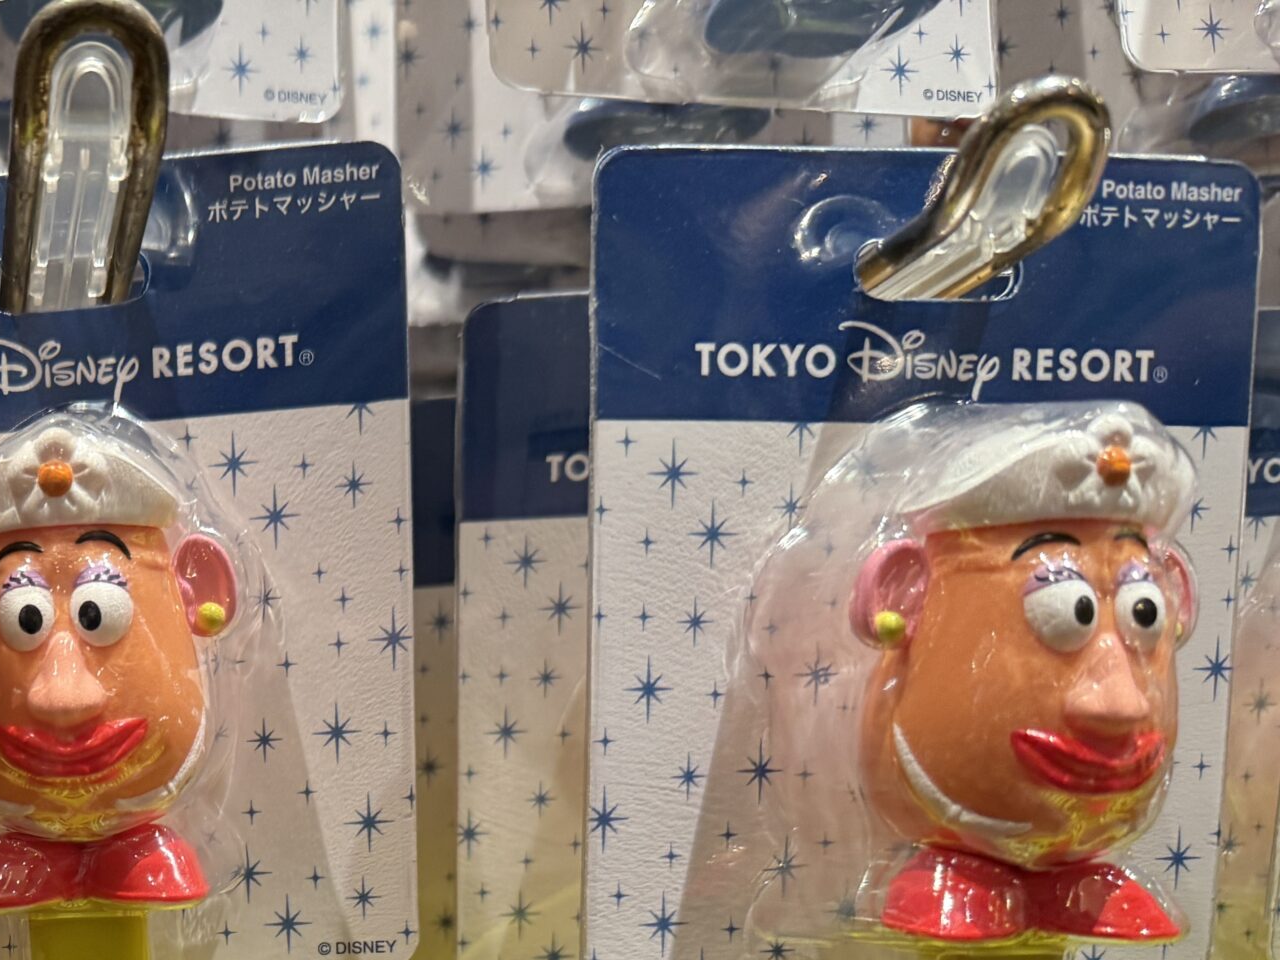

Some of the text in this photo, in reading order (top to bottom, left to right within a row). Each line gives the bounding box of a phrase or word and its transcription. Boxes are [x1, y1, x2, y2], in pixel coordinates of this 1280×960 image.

[277, 90, 327, 104] DISNEY
[936, 89, 982, 103] DISNEY
[229, 162, 380, 192] Potato Masher
[1102, 179, 1243, 202] Potato Masher
[208, 192, 381, 223] ポテトマッシャー
[1079, 204, 1242, 231] ポテトマッシャー
[695, 342, 837, 378] TOKYO
[838, 320, 1001, 401] Disney
[335, 940, 397, 955] DISNEY
